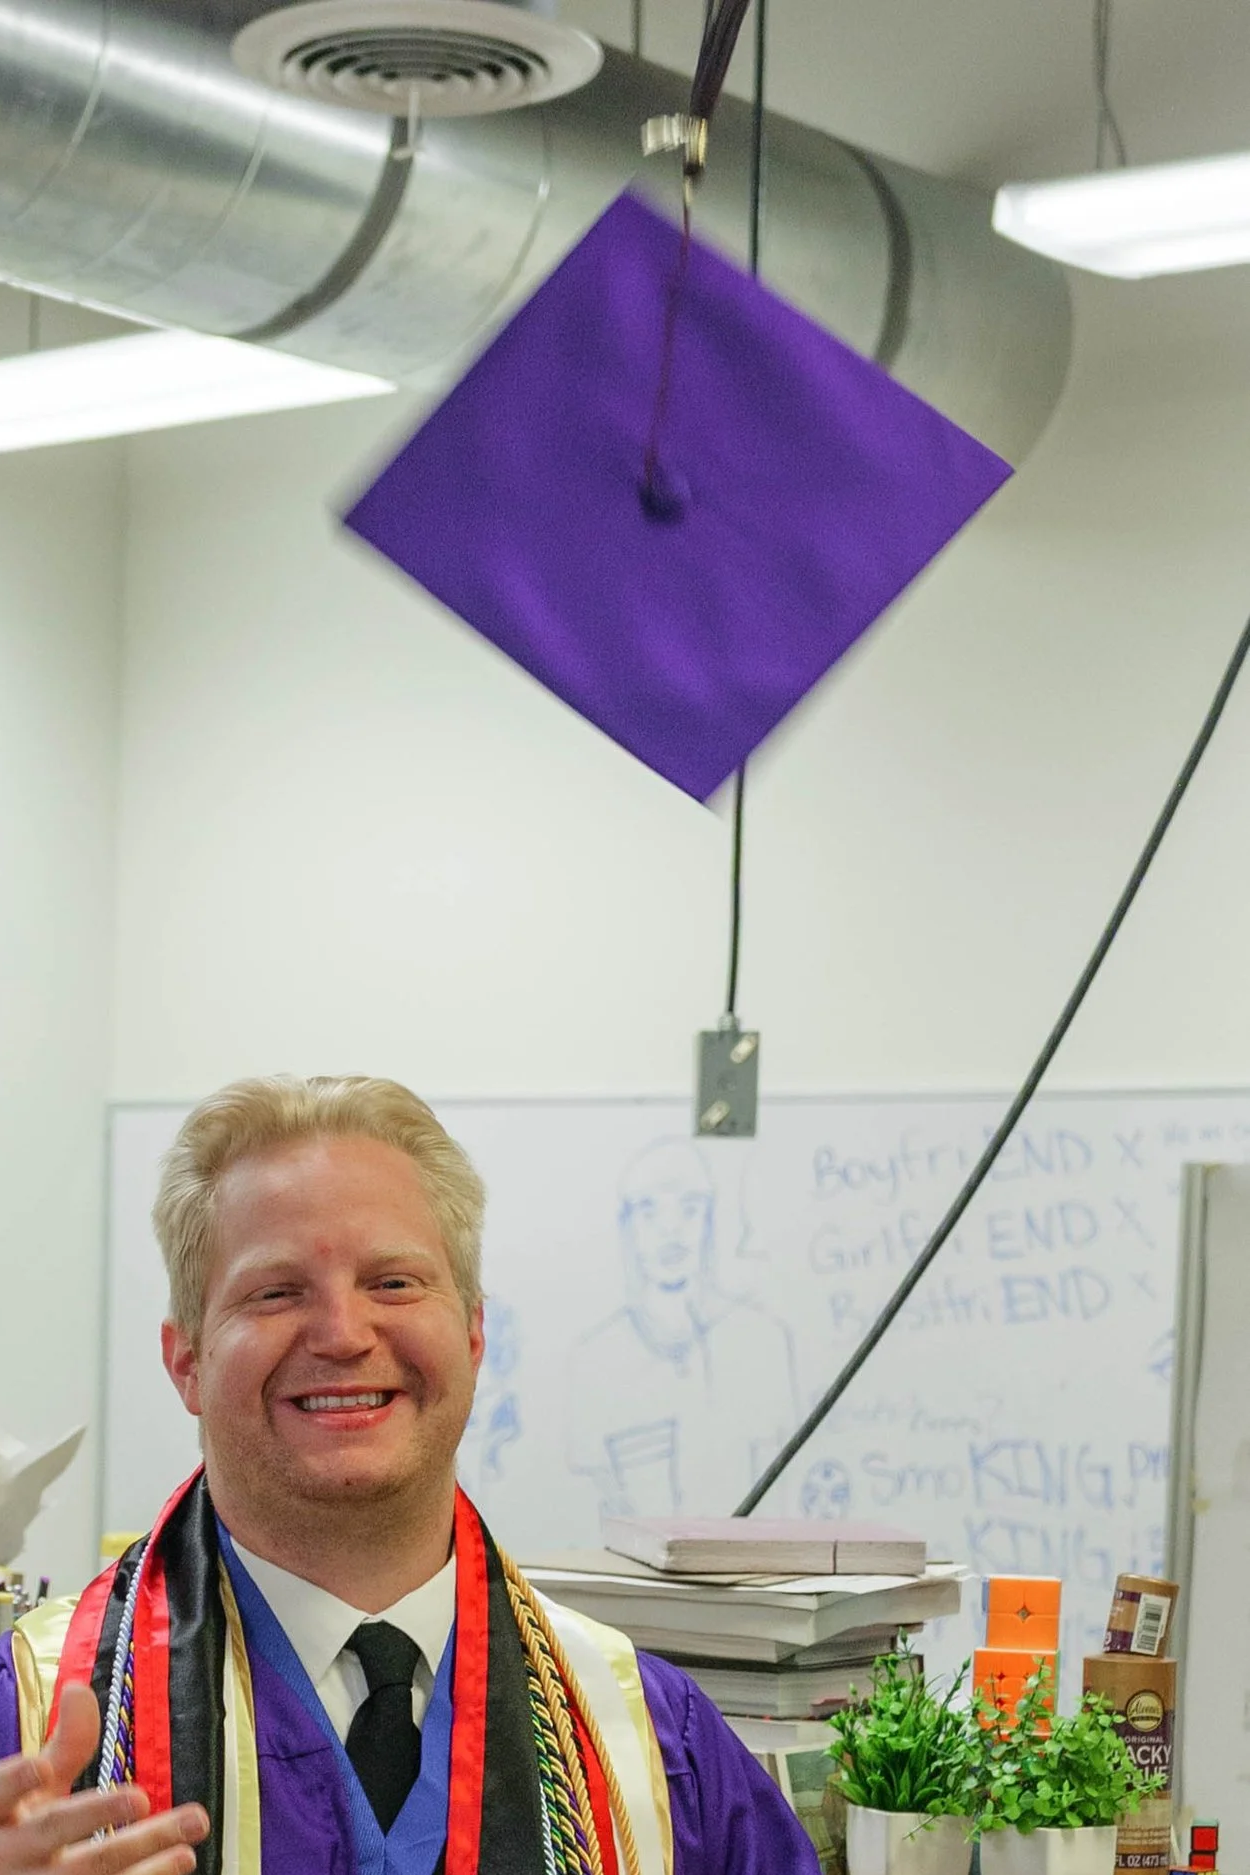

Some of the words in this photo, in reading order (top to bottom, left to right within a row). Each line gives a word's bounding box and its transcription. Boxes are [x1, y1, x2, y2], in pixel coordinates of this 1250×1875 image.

[1124, 1735, 1165, 1744] ORIGINAL
[1126, 1745, 1173, 1766] ACKY
[1127, 1854, 1141, 1867] OZ
